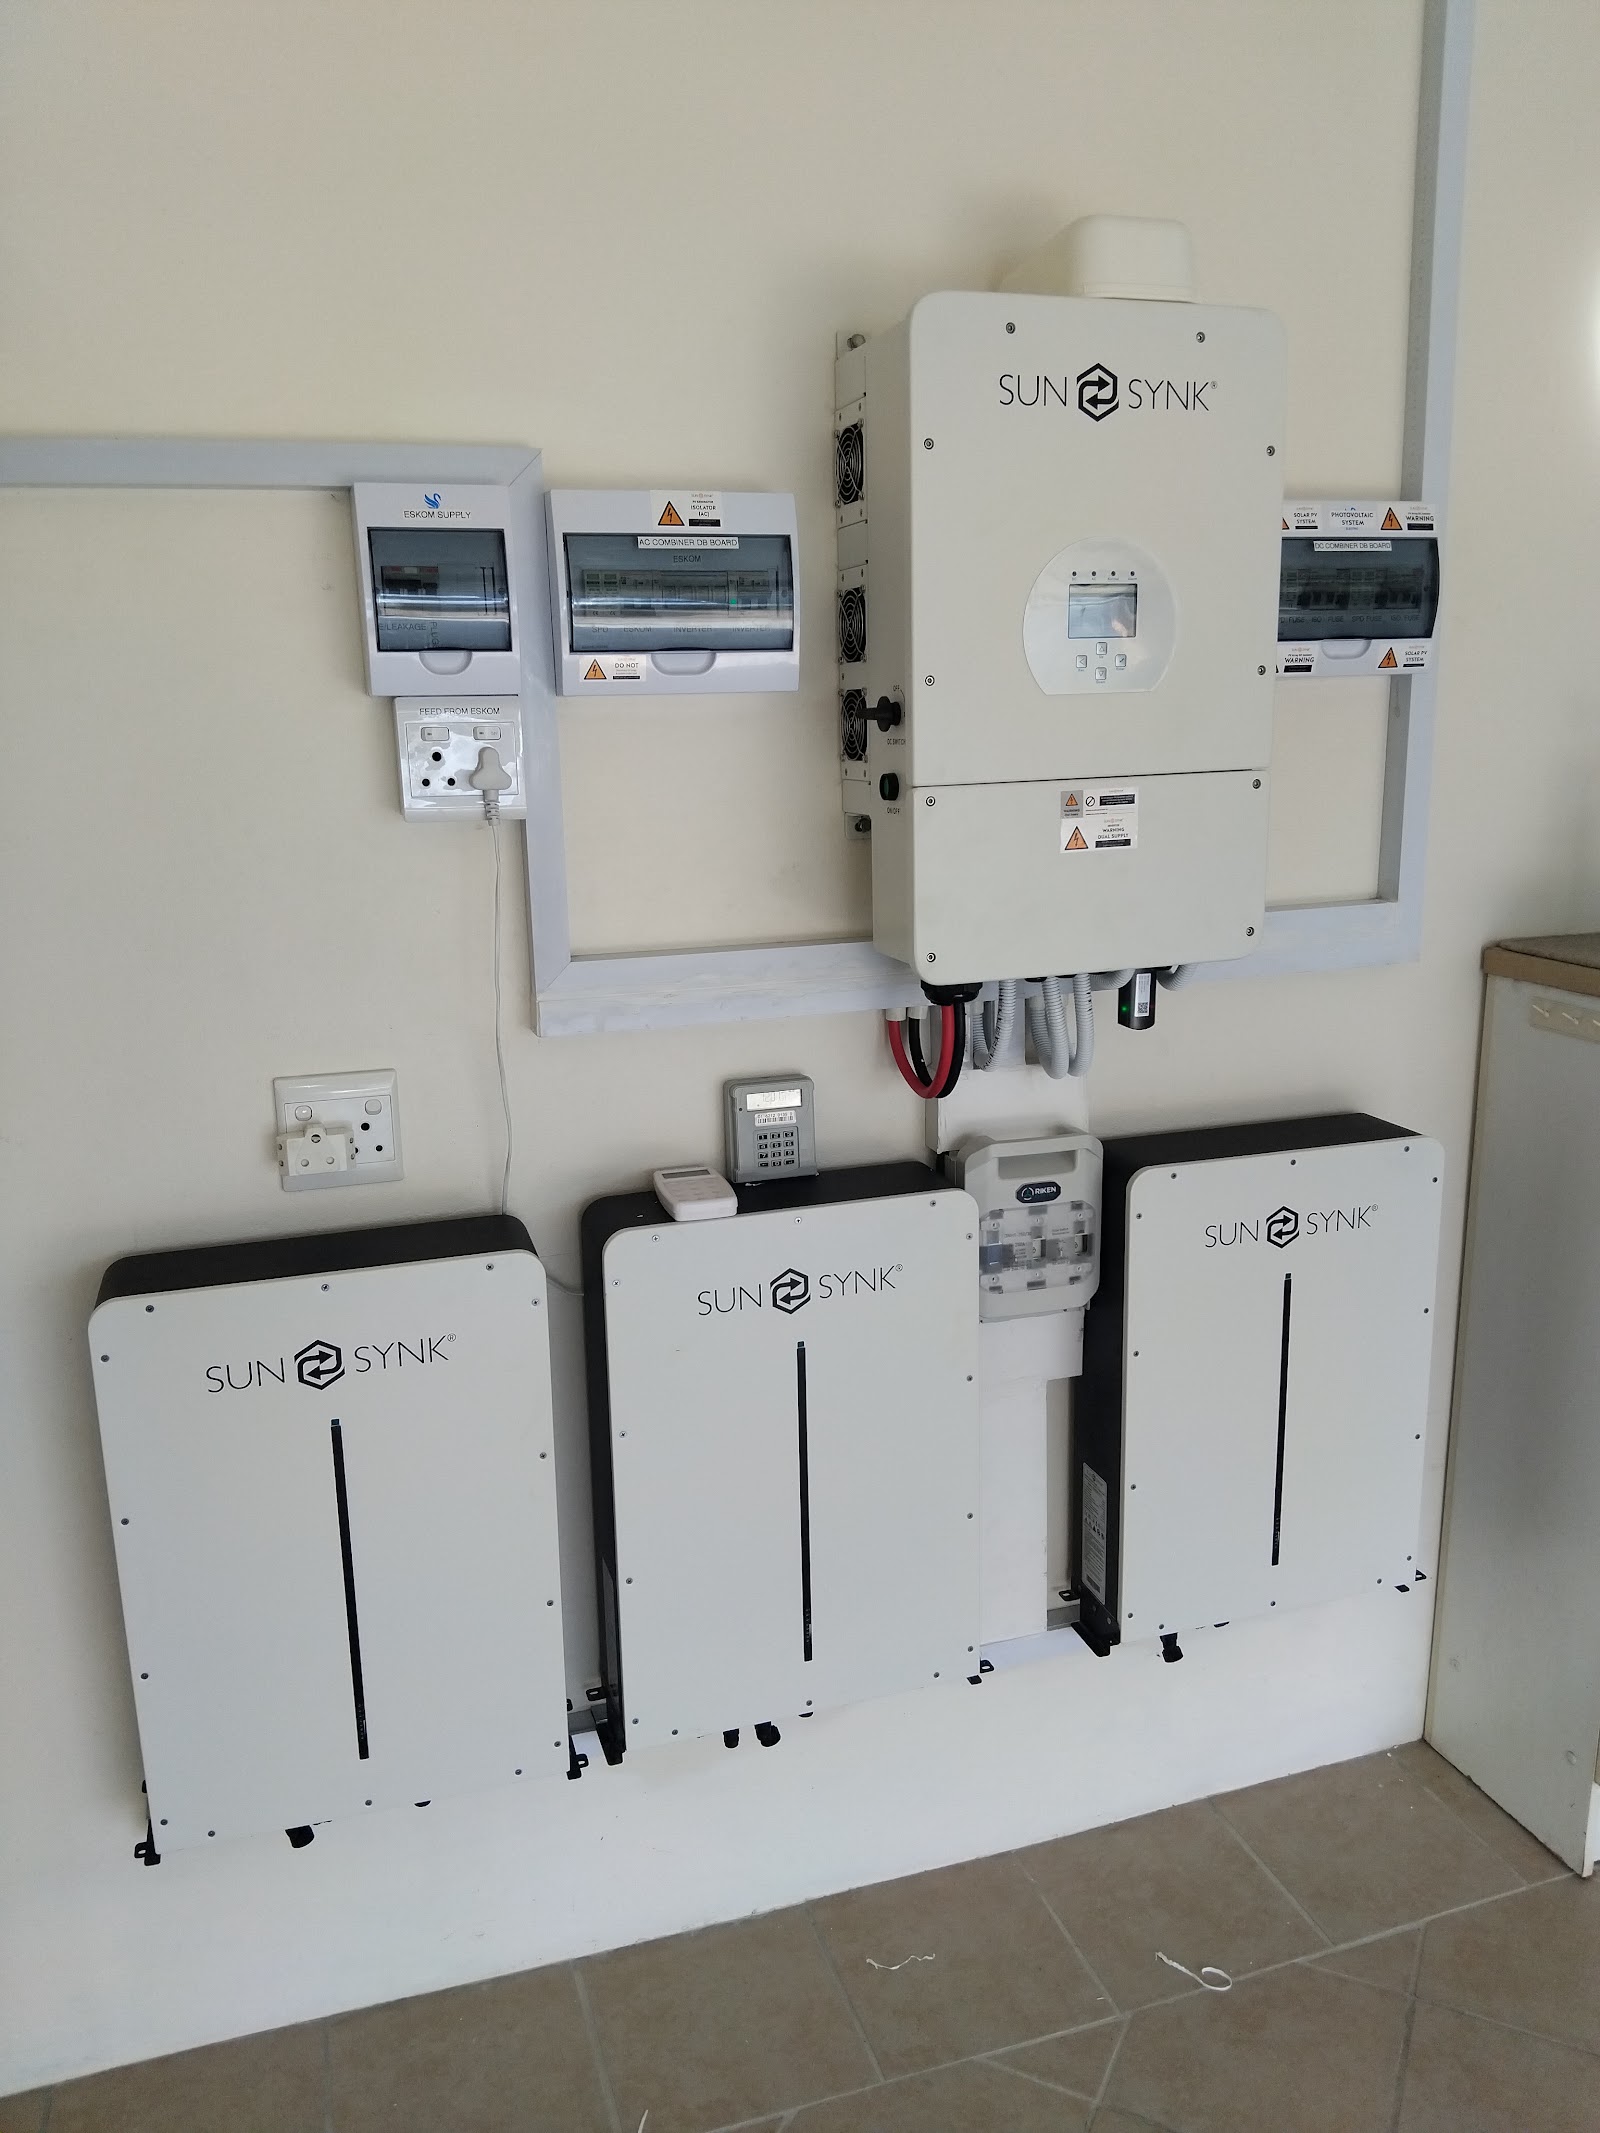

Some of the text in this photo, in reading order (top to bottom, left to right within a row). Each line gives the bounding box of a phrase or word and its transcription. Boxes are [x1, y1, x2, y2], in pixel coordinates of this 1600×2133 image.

[999, 374, 1067, 406] SUN
[404, 510, 472, 519] ESKOM SUPPLY
[639, 538, 651, 546] AC
[710, 539, 738, 547] BOARD
[1315, 542, 1325, 550] DC
[1369, 541, 1391, 549] BOARD
[673, 555, 701, 563] ESKOM
[673, 625, 713, 633] INVERTER
[419, 707, 501, 716] FEED FROM ESKOM
[1034, 1186, 1057, 1195] RIKEN
[1205, 1219, 1259, 1248] SUN
[697, 1283, 762, 1316] SUN
[205, 1357, 285, 1393] SUN
